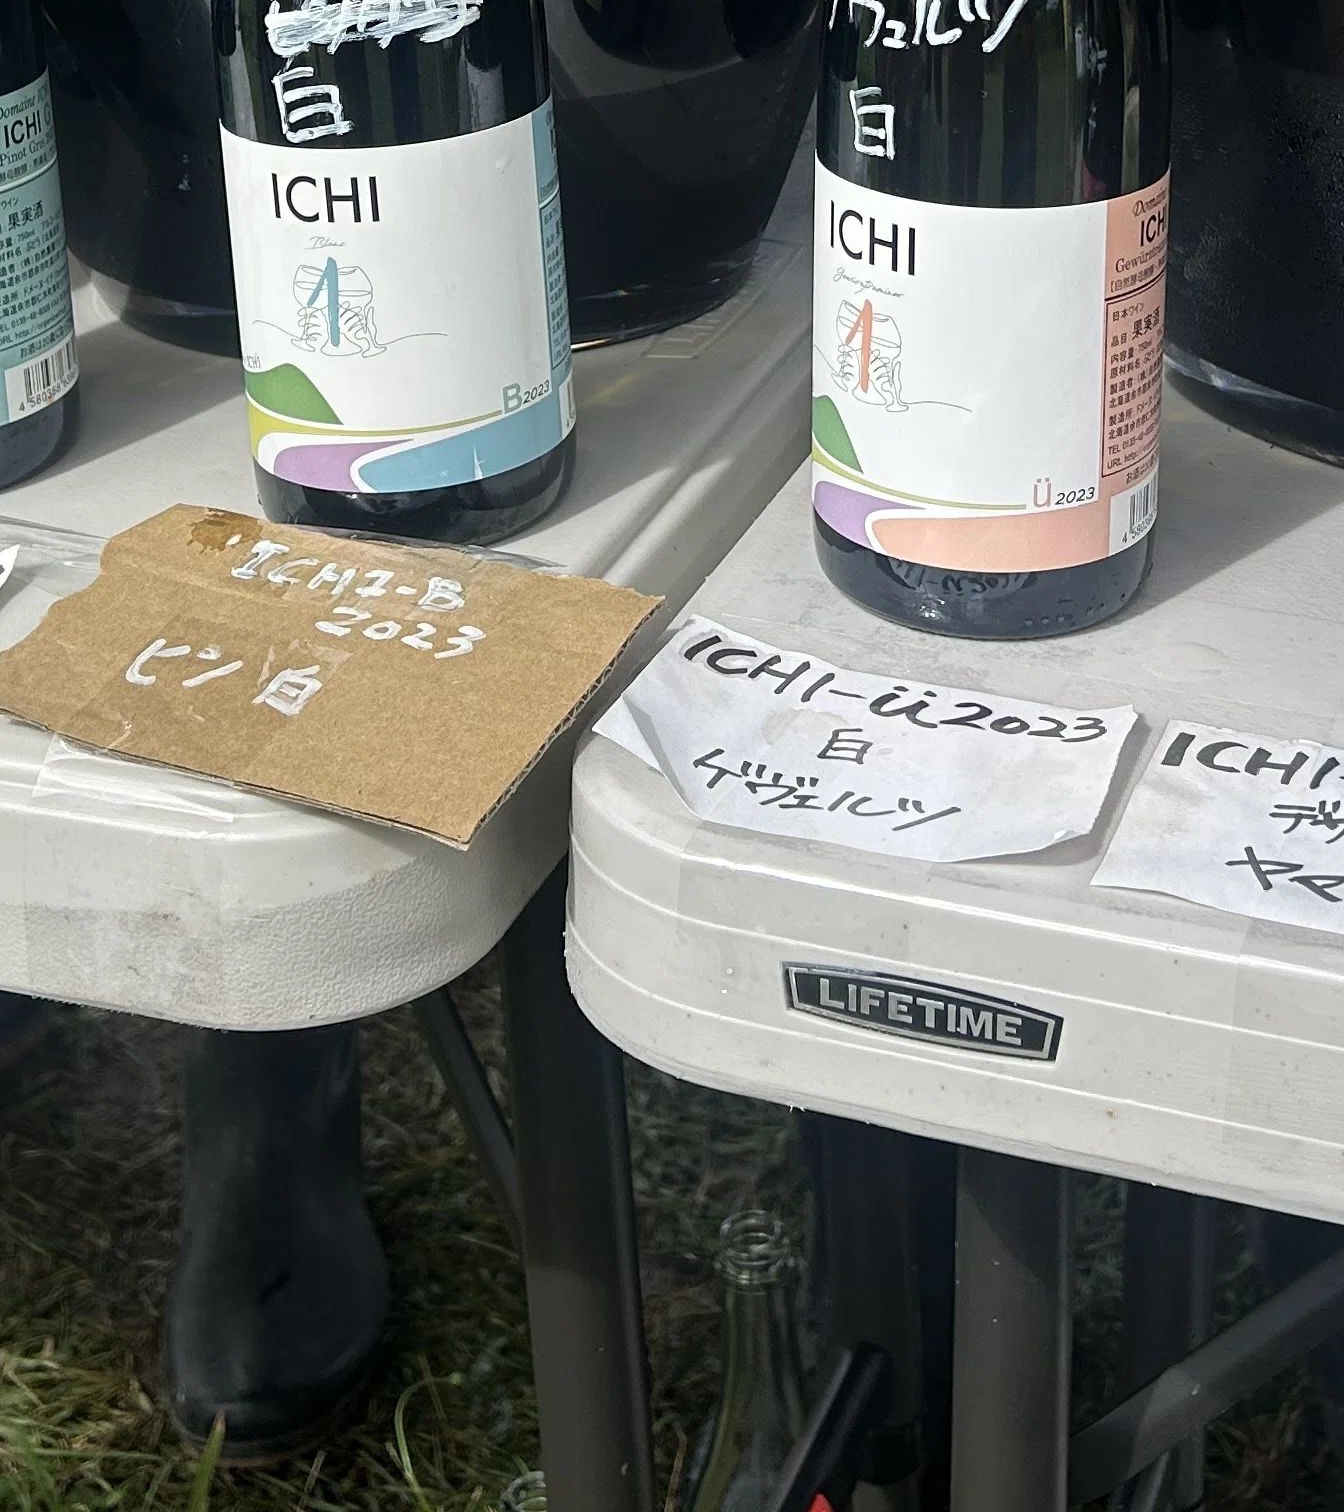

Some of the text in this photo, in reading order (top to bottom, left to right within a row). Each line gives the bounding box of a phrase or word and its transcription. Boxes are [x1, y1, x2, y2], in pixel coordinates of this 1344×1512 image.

[270, 62, 354, 144] 白
[3, 110, 42, 149] ICHI
[8, 199, 44, 231] 果実酒
[270, 171, 380, 224] ICHI
[829, 199, 917, 276] ICHI
[502, 380, 551, 417] B 2023
[1033, 477, 1096, 508] Ü 2023
[315, 605, 487, 660] 2023
[817, 728, 872, 765] 白
[819, 977, 1022, 1046] LIFETIME
